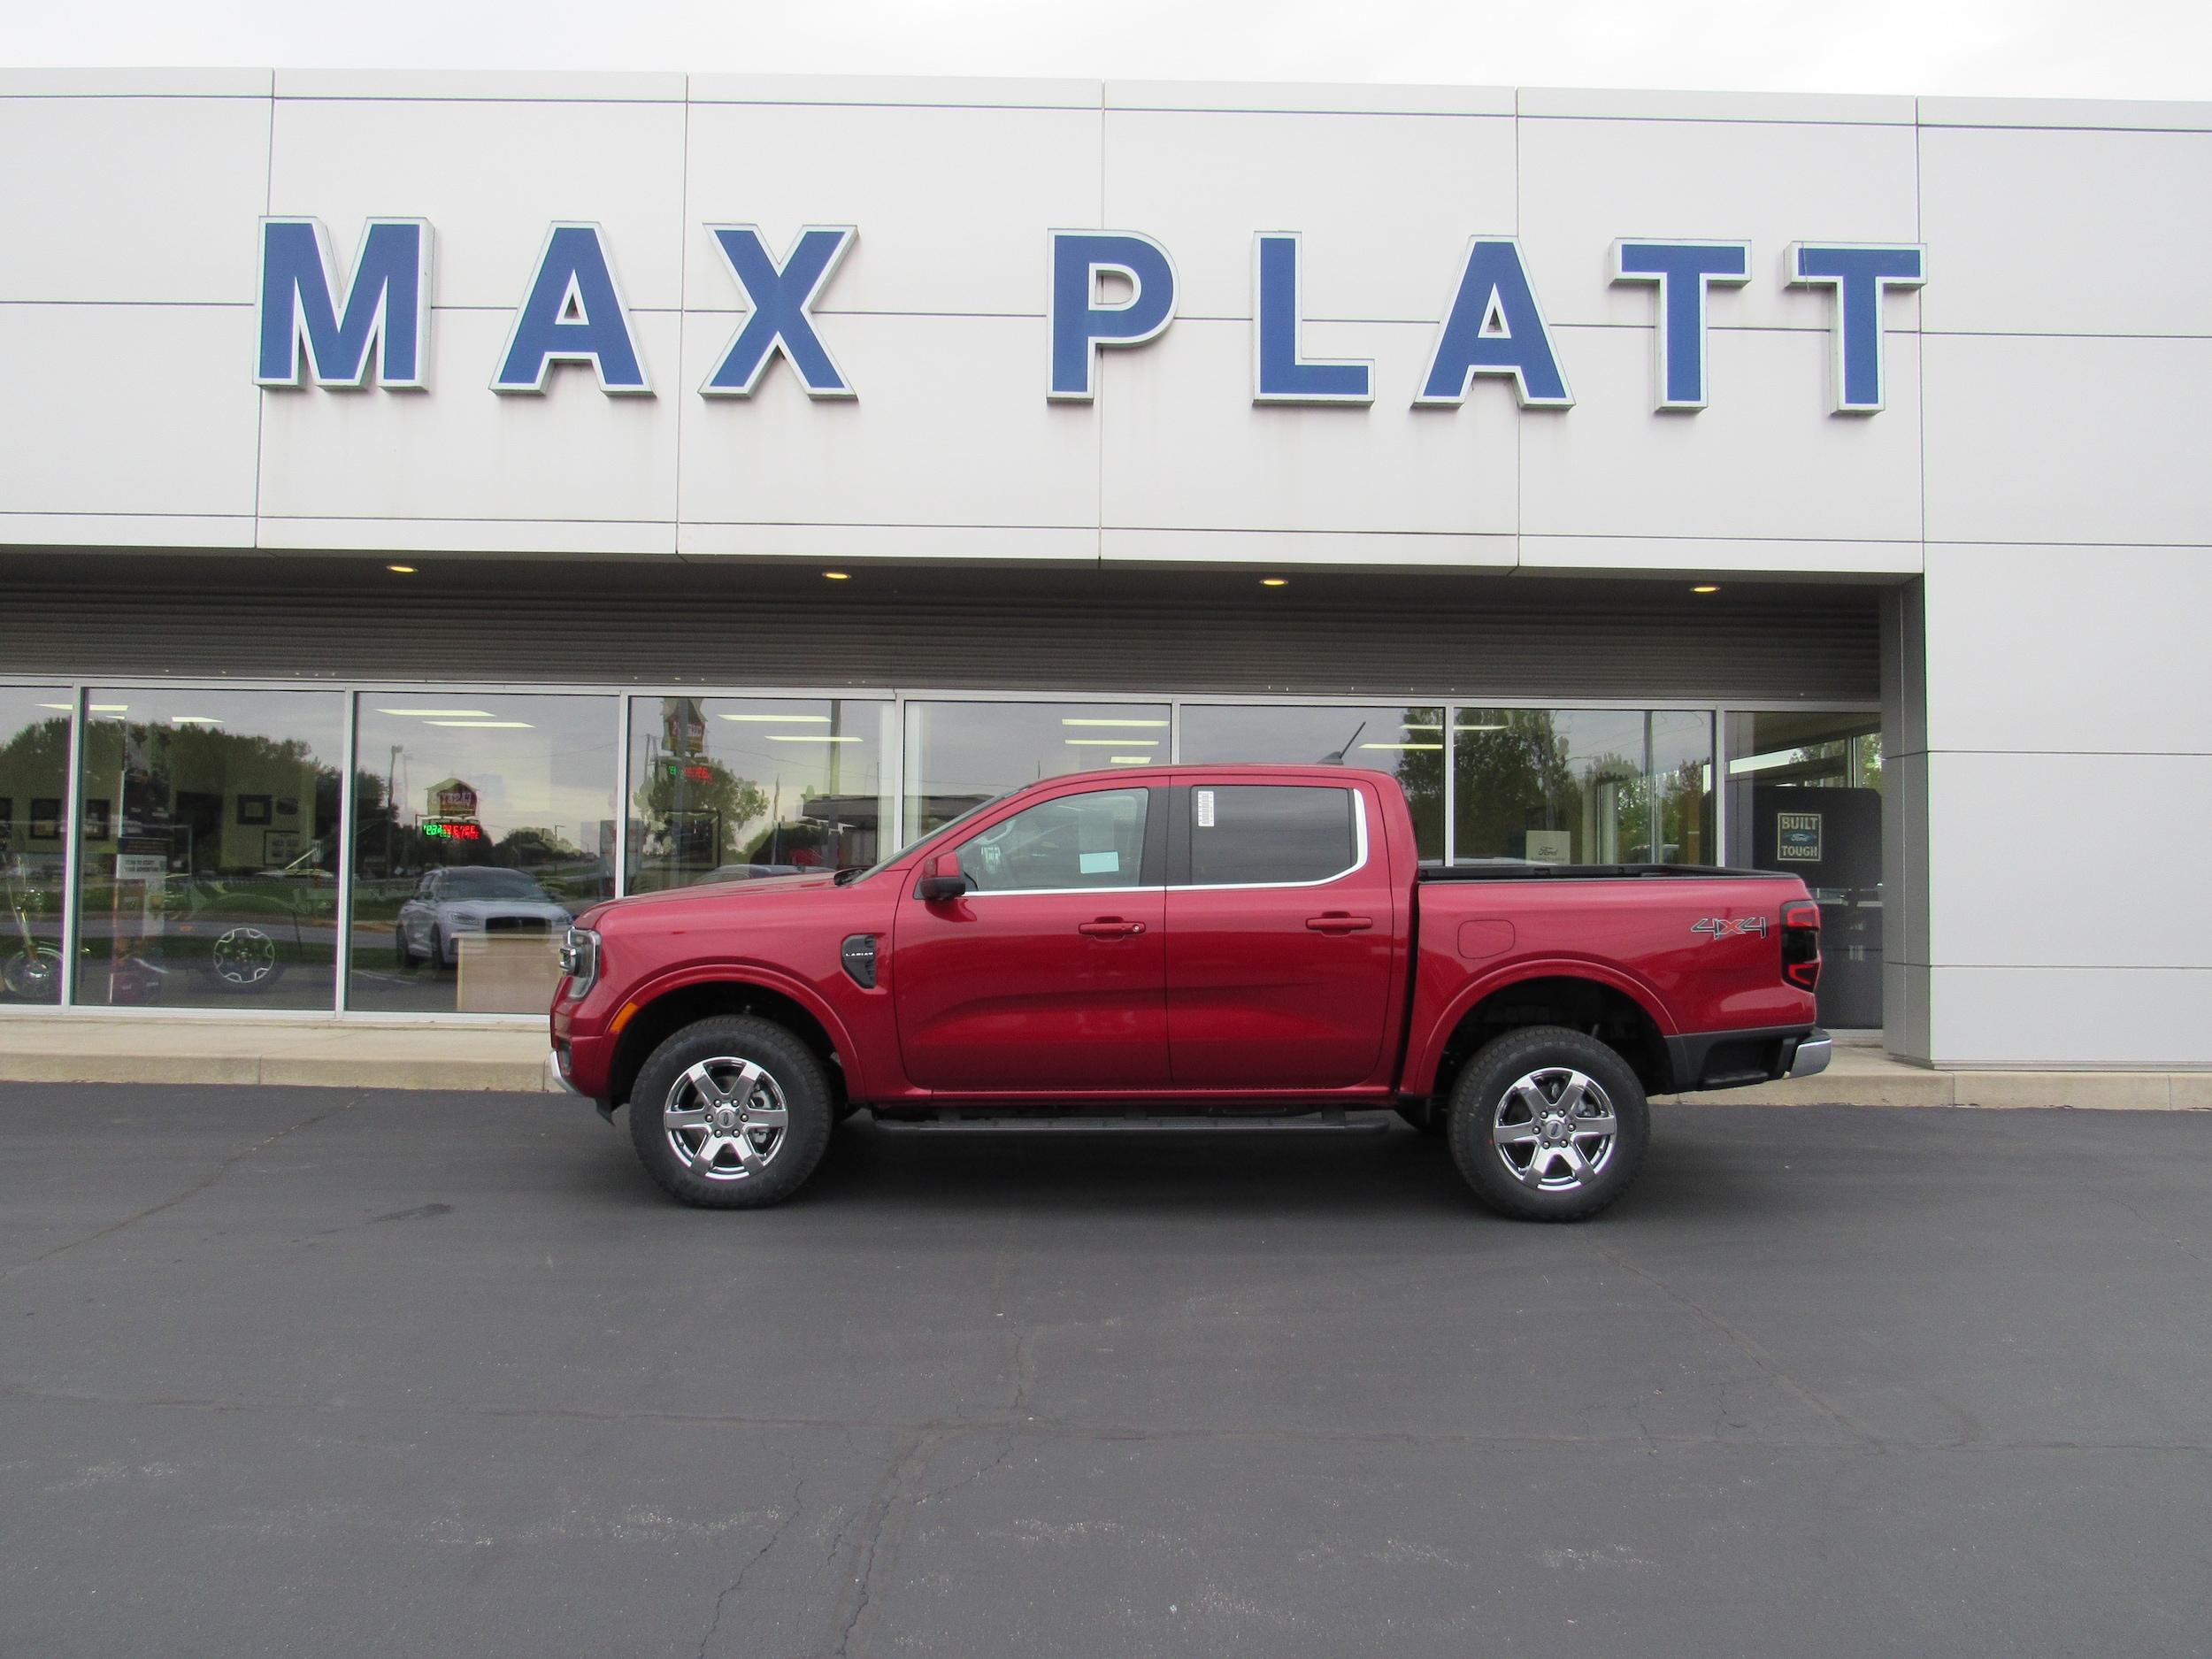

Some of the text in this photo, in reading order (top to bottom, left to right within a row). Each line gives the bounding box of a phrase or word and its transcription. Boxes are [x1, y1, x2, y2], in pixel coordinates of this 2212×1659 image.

[252, 216, 1928, 415] MAX PLATT
[1781, 816, 1818, 830] BUILT
[1539, 846, 1558, 856] Ford
[1781, 845, 1818, 856] TOUGH
